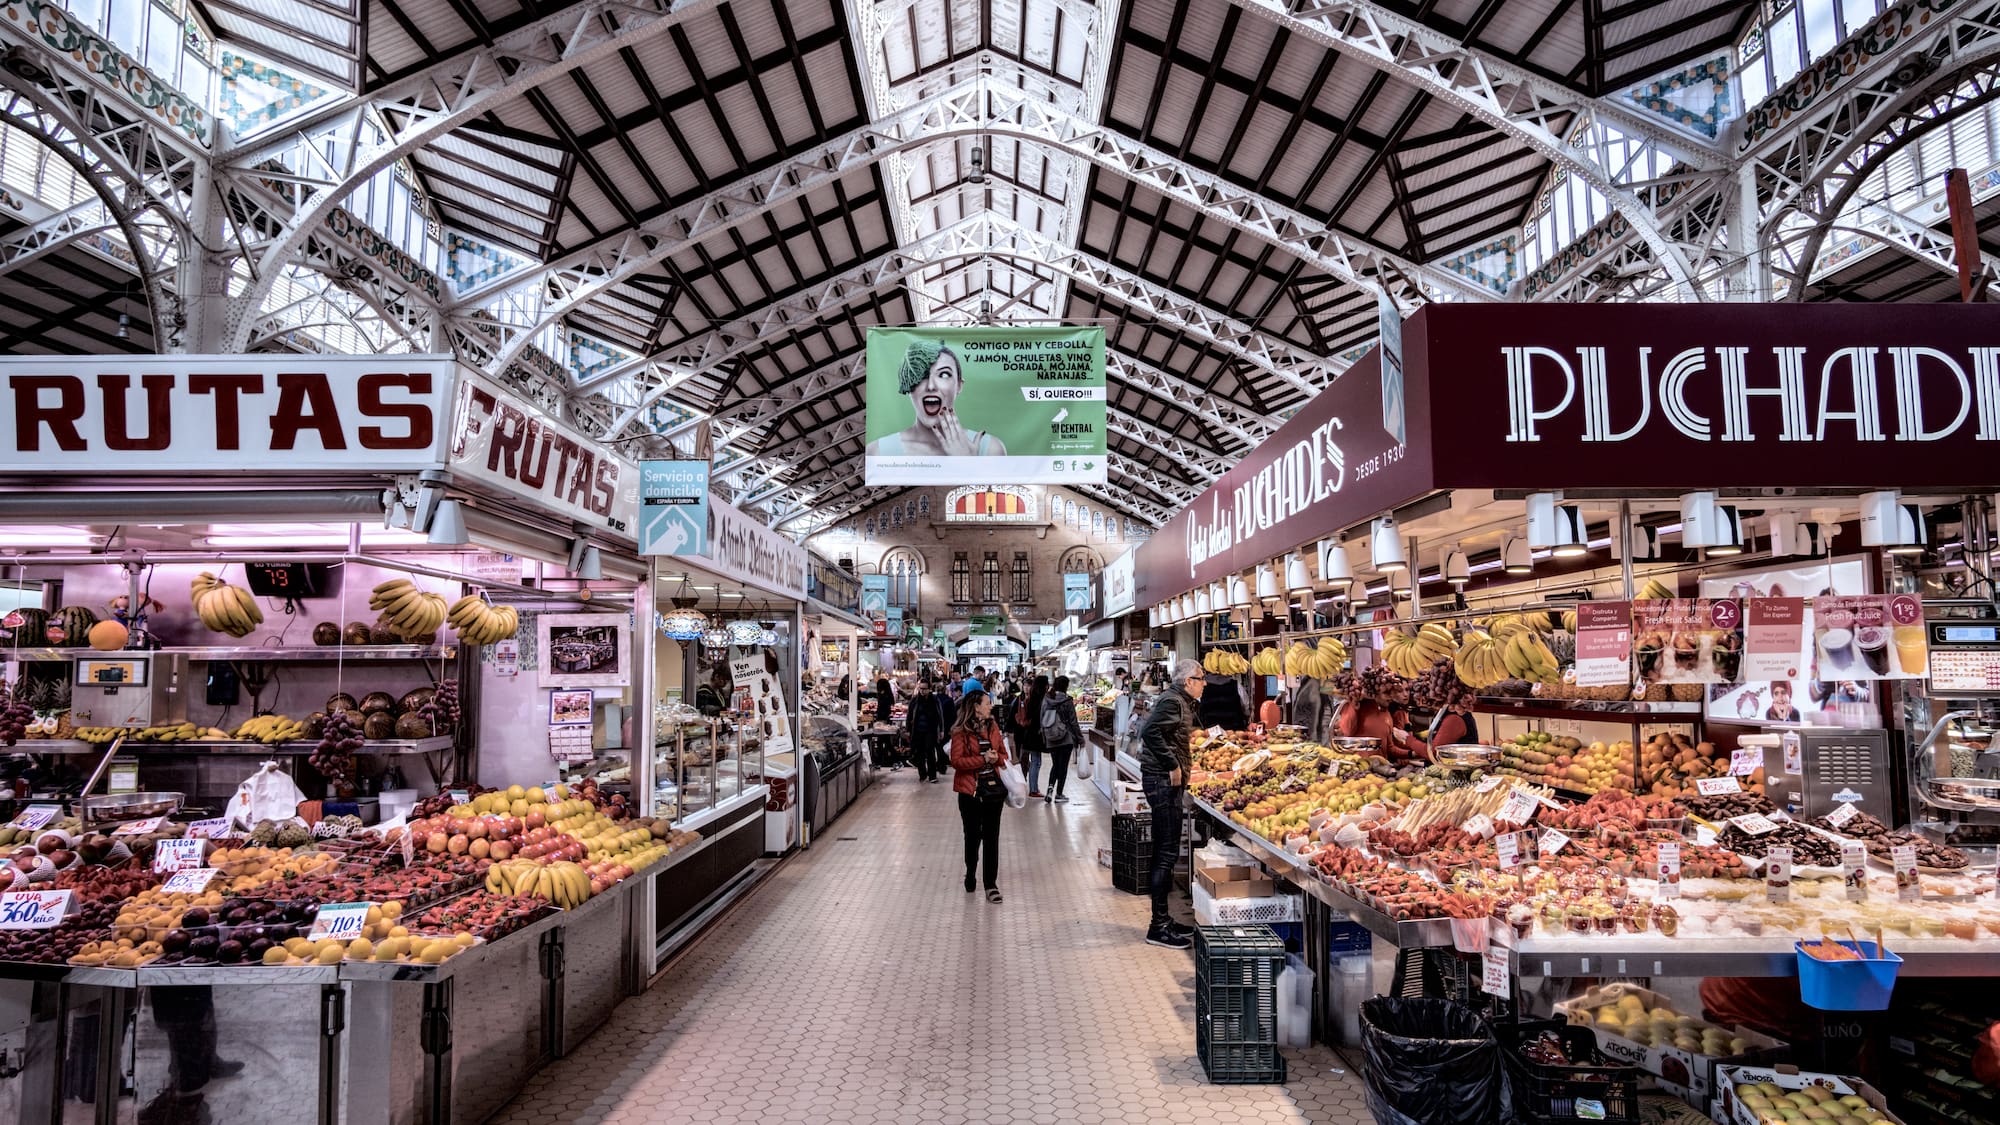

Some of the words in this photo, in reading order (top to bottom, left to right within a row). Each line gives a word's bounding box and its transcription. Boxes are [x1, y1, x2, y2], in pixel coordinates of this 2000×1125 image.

[964, 341, 1010, 350] CONTIGO
[1013, 341, 1032, 350] PAN
[1036, 341, 1042, 349] Y
[964, 354, 971, 362] Y
[973, 352, 1011, 364] JAMÓN,
[1014, 353, 1064, 363] CHULETAS,
[1067, 353, 1093, 363] VINO,
[1003, 362, 1047, 372] DORADA,
[1029, 388, 1041, 400] SÍ,
[1044, 389, 1093, 399] QUIERO!!!
[9, 373, 434, 452] RUTAS
[1060, 423, 1093, 433] CENTRAL
[453, 380, 620, 517] FRUTAS
[1355, 455, 1380, 482] DESDE
[1383, 443, 1404, 467] 1930
[644, 469, 694, 482] Servicio
[696, 473, 704, 482] a
[1234, 417, 1344, 543] PUCHADES
[646, 484, 702, 497] domicilio
[265, 569, 288, 587] 79
[1645, 616, 1664, 625] Fresh
[1665, 616, 1682, 624] Fruit
[1683, 616, 1703, 624] Salad
[1824, 612, 1844, 620] Fresh
[1846, 611, 1863, 620] Fruit
[1864, 611, 1881, 619] Juice
[734, 663, 750, 671] Ven
[15, 893, 42, 902] UVA
[1742, 1074, 1775, 1083] VENOSTA
